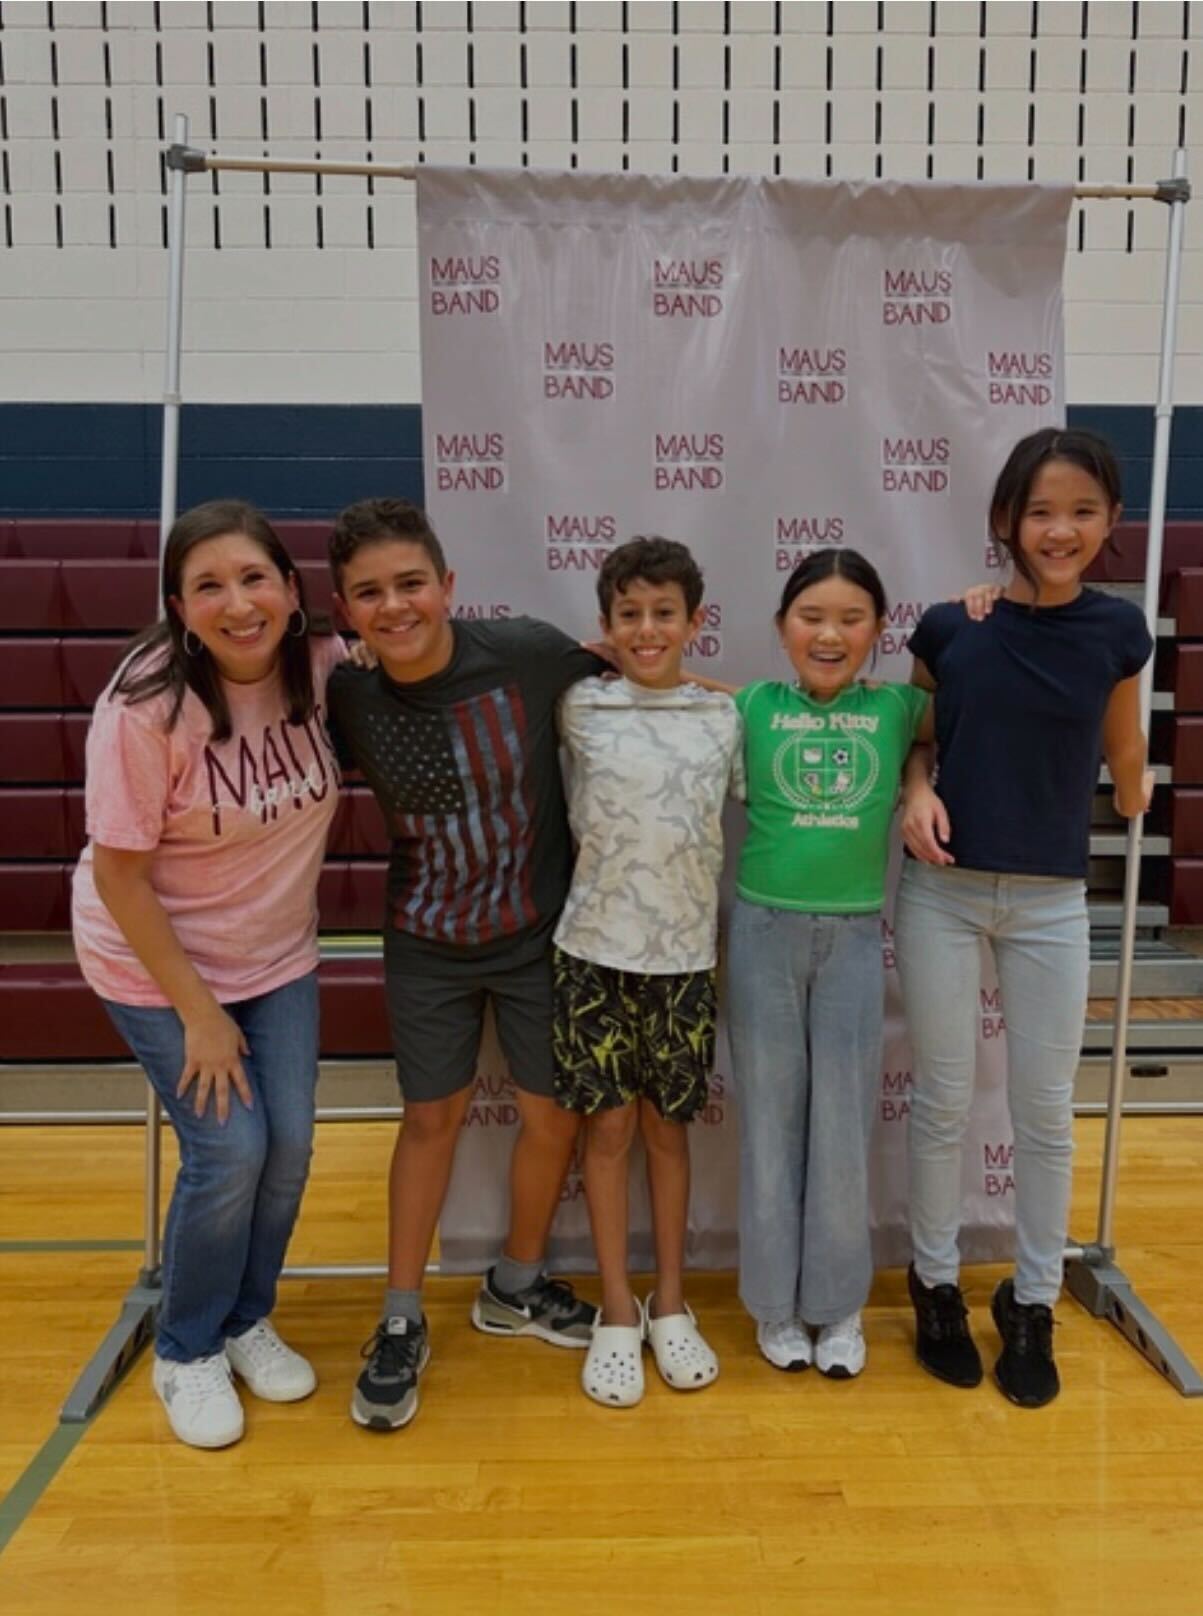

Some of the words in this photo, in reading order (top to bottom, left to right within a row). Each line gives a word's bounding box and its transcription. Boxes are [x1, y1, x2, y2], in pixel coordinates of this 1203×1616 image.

[431, 256, 500, 280] MAUS
[654, 260, 723, 284] MAUS
[884, 269, 952, 293] MAUS
[431, 289, 500, 315] BAND
[654, 294, 723, 317] BAND
[883, 302, 951, 325] BAND
[544, 342, 614, 367] MAUS
[779, 347, 846, 372] MAUS
[988, 352, 1052, 375] MAUS
[544, 375, 614, 399] BAND
[778, 381, 845, 404] BAND
[988, 384, 1052, 405] BAND
[436, 433, 504, 457] MAUS
[655, 433, 724, 457] MAUS
[883, 438, 950, 461] MAUS
[437, 467, 504, 490] BAND
[655, 467, 723, 490] BAND
[883, 469, 948, 492] BAND
[547, 515, 616, 538] MAUS
[777, 518, 843, 540] MAUS
[776, 549, 804, 571] BA
[887, 602, 922, 625] MA
[683, 635, 720, 657] ND
[880, 633, 910, 655] BA
[770, 712, 825, 731] Hello
[792, 812, 859, 829] Athletics
[981, 1017, 1006, 1039] BA
[471, 1075, 517, 1097] AUS
[882, 1072, 914, 1092] MA
[465, 1103, 520, 1127] AND
[694, 1103, 724, 1126] ND
[882, 1102, 911, 1122] BA
[984, 1144, 1014, 1165] MA
[984, 1174, 1016, 1196] BA
